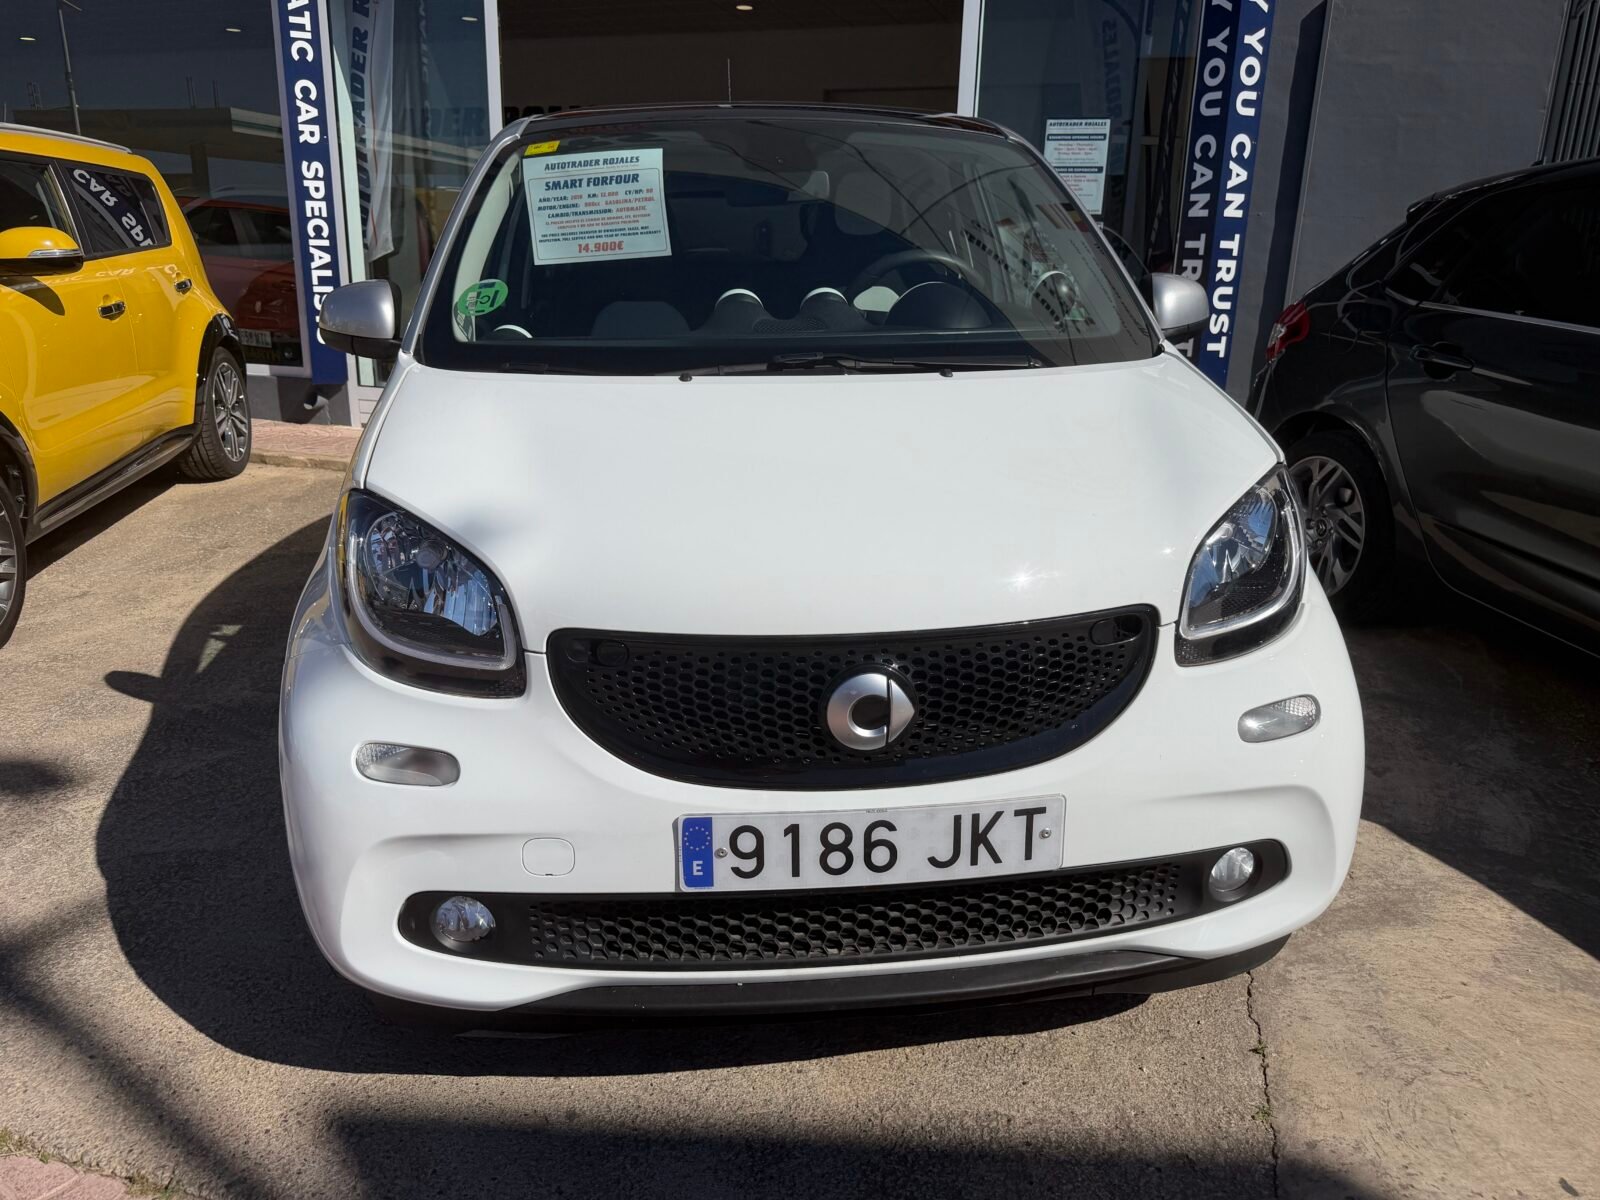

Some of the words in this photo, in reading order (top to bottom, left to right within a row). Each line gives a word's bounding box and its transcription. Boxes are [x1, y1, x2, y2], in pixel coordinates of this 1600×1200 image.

[294, 79, 320, 144] CAR
[1200, 26, 1230, 116] YOU
[1236, 27, 1266, 116] YOU
[544, 159, 600, 170] AUTOTRADER
[602, 155, 639, 165] ROJALES
[544, 178, 583, 190] SMART
[586, 173, 639, 187] FORFOUR
[1187, 134, 1217, 217] CAN
[1223, 133, 1252, 218] CAN
[302, 157, 334, 345] SPECIALI
[577, 240, 624, 253] 14.900€
[1176, 233, 1206, 357] TRT
[1206, 233, 1240, 358] TRUST
[692, 860, 704, 876] E
[728, 819, 899, 879] 9186
[926, 806, 1048, 869] JKT
